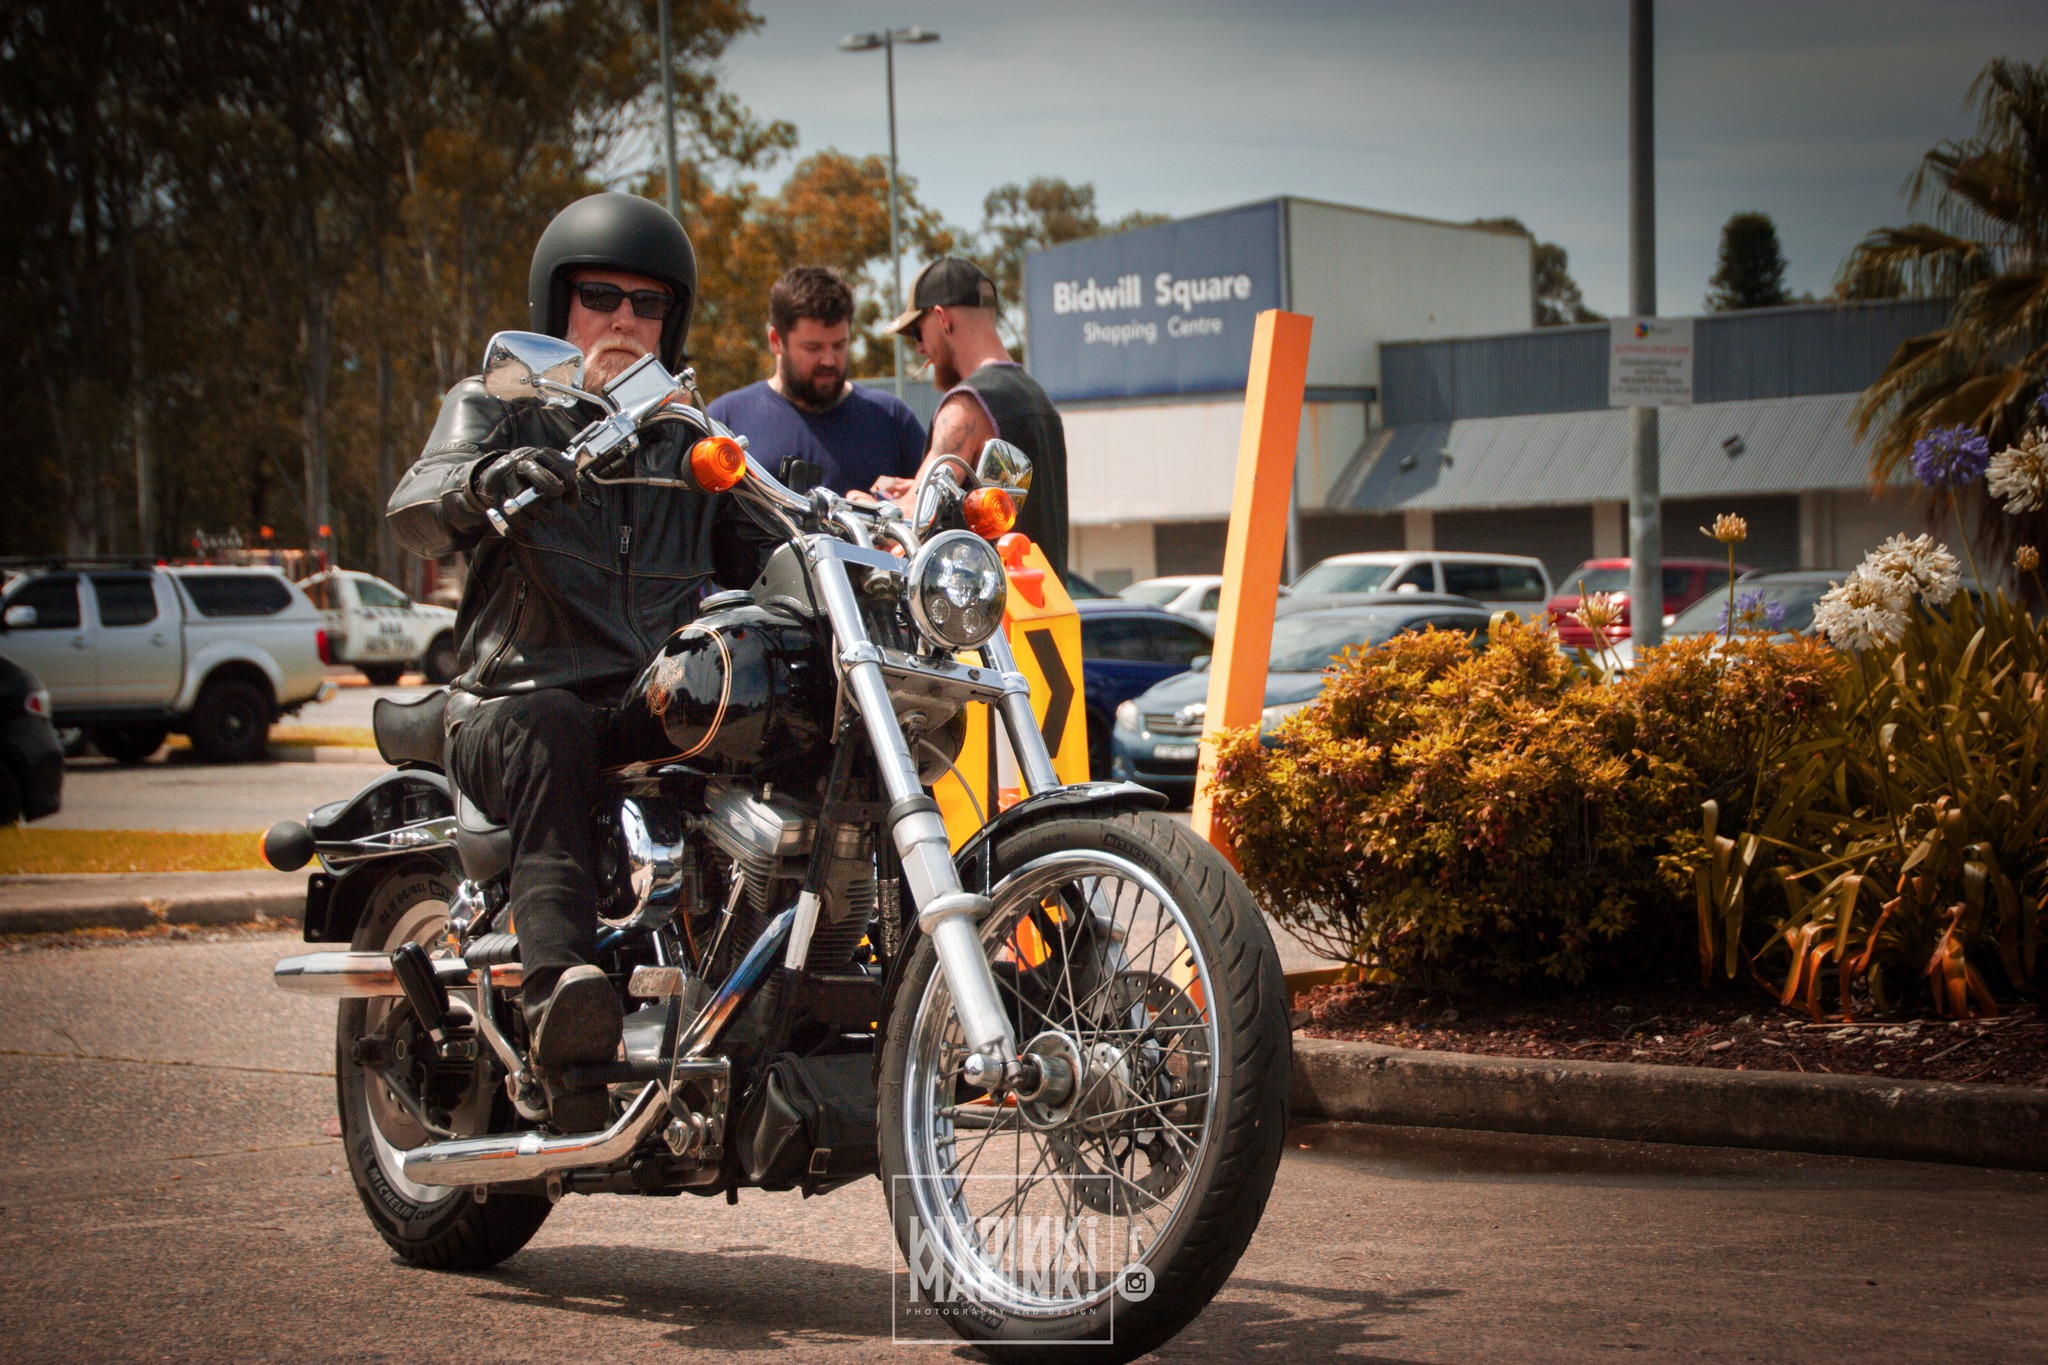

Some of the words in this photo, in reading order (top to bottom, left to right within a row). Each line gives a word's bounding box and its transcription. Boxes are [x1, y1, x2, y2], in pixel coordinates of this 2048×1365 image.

[1053, 273, 1141, 314] Bidwill
[1155, 272, 1251, 312] Square
[1083, 318, 1158, 345] Shopping
[1167, 315, 1223, 338] Centre
[367, 1166, 417, 1218] MICHELIN
